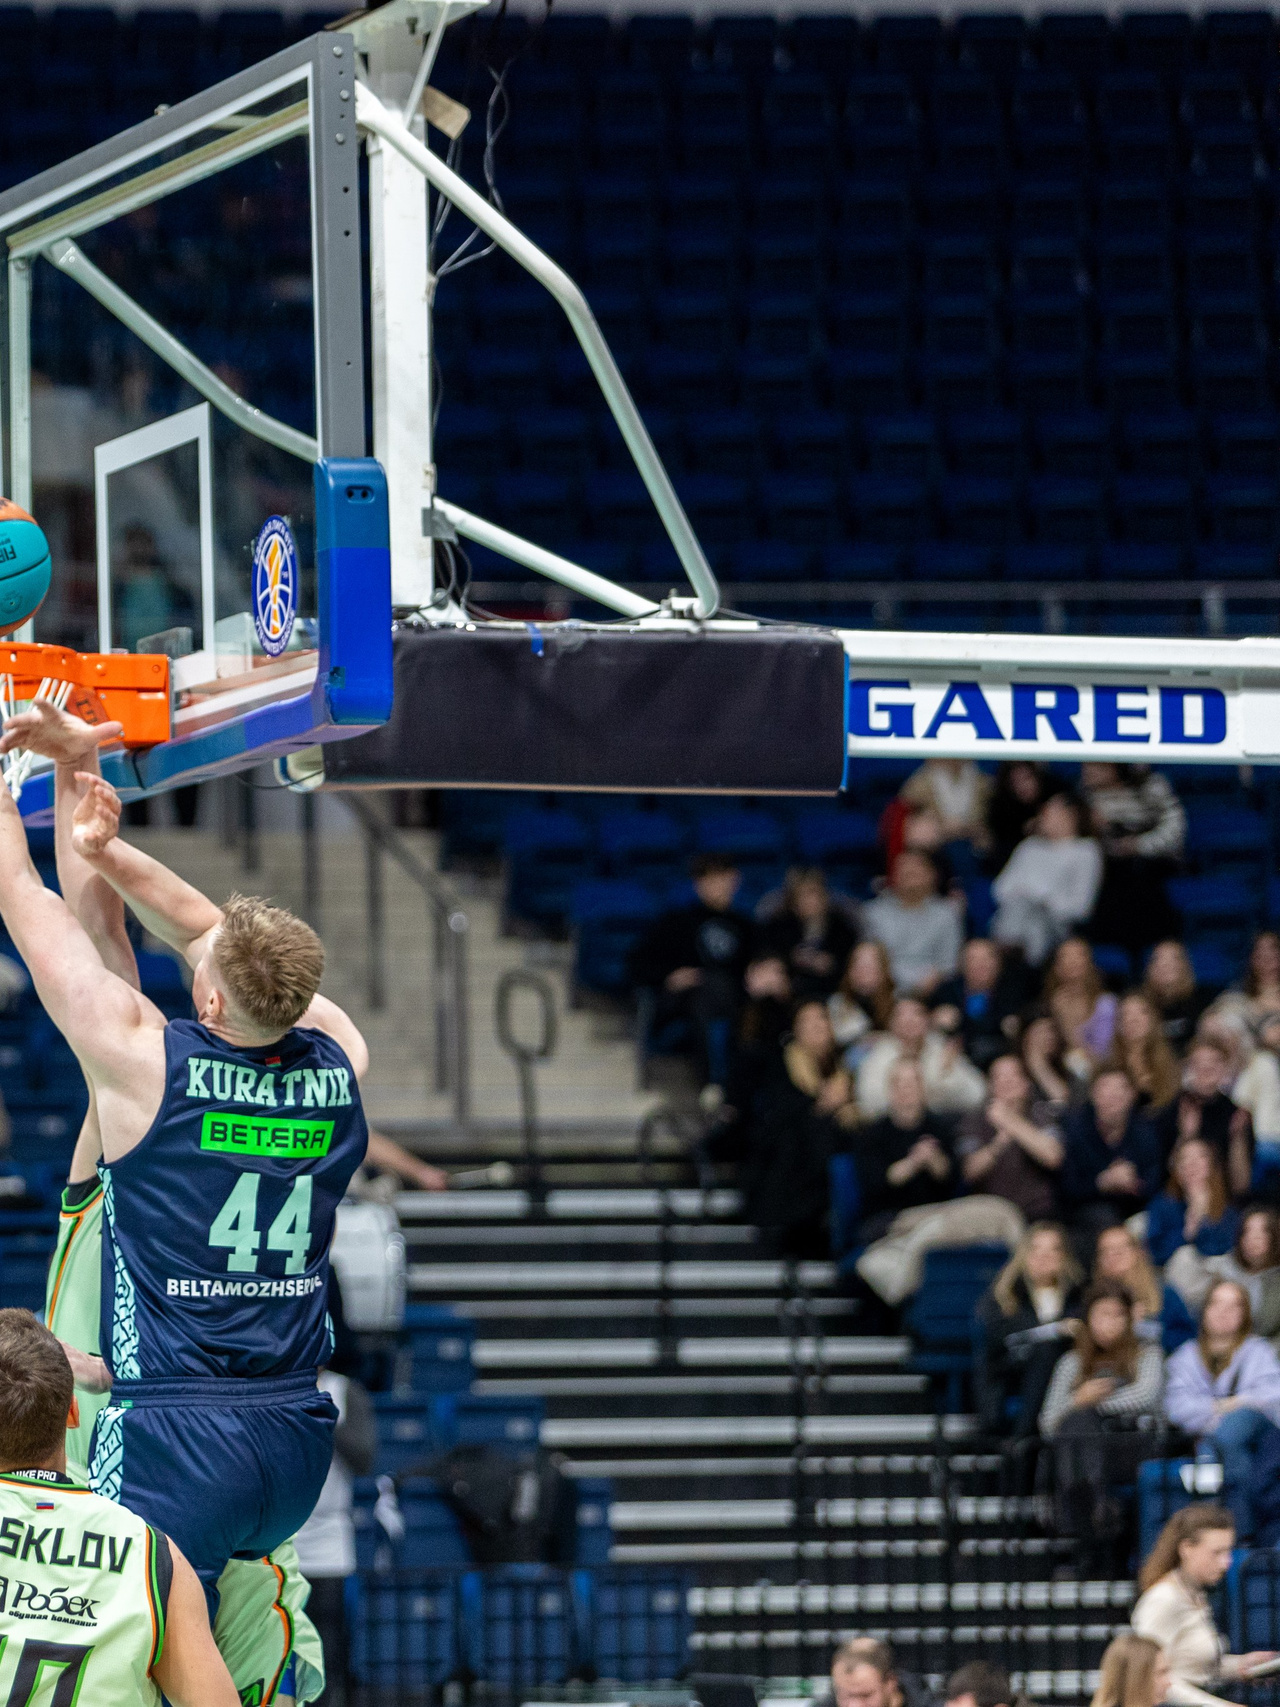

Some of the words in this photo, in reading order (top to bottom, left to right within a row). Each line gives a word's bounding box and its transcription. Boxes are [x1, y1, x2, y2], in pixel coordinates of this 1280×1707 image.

[848, 679, 1226, 744] GARED
[185, 1057, 353, 1107] KURATNIK
[210, 1121, 326, 1149] BETERA
[208, 1172, 313, 1275] 44
[37, 1469, 57, 1482] PRO
[8, 1610, 48, 1620] обувная
[51, 1614, 98, 1627] компания
[12, 1580, 100, 1619] Робек
